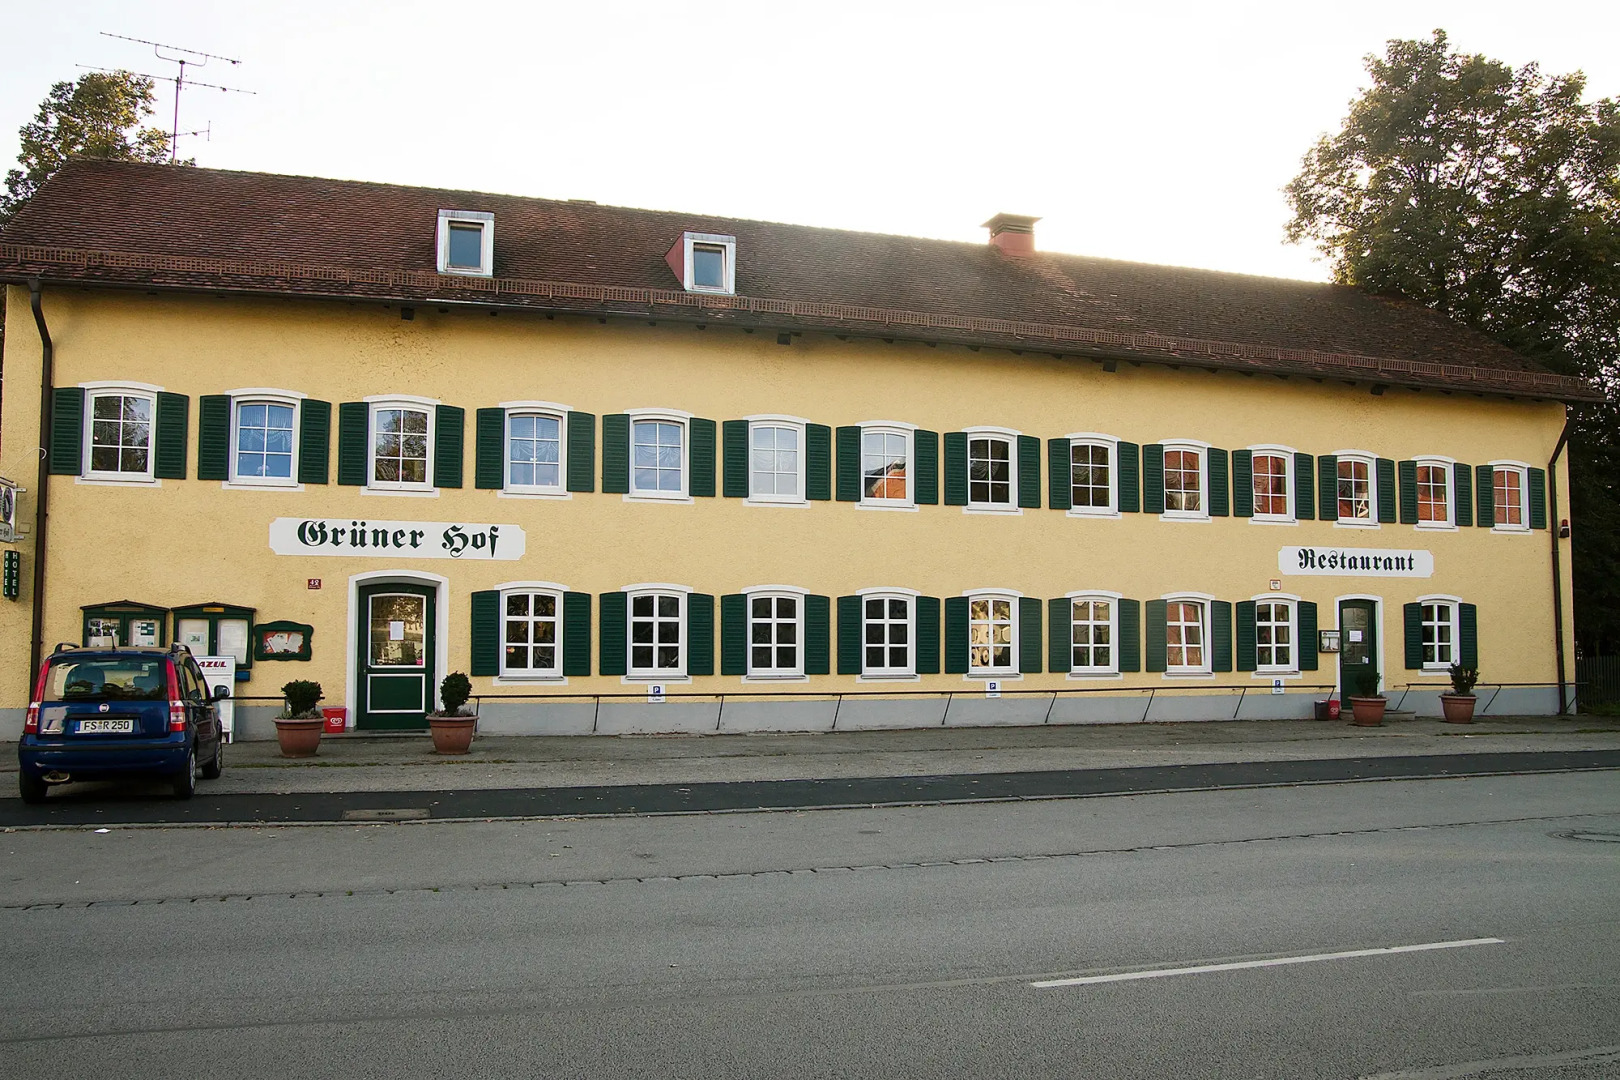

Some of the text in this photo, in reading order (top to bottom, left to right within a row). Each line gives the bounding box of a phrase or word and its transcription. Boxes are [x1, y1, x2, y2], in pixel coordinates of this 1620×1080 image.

[297, 520, 499, 558] Grüner Hof
[1298, 548, 1415, 571] Restaurant
[83, 720, 130, 731] FS R 250
